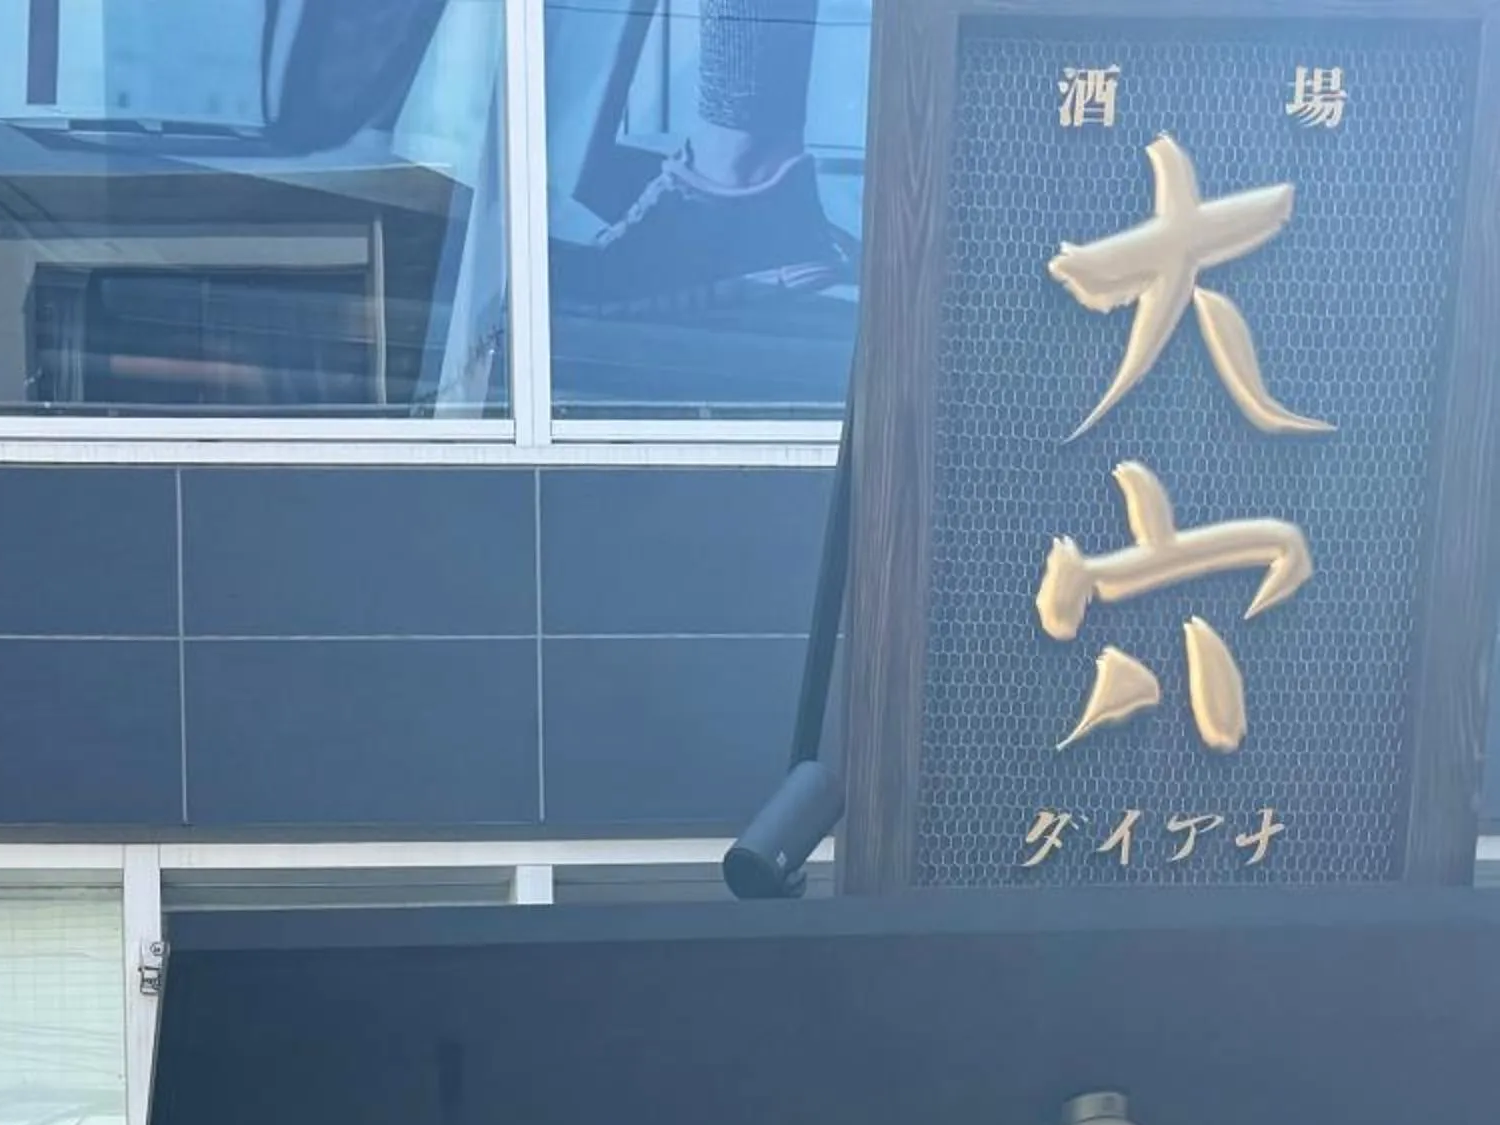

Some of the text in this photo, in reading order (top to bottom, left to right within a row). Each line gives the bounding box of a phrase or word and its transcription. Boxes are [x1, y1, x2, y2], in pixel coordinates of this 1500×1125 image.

[1058, 64, 1349, 130] 酒場
[1036, 132, 1338, 753] 大穴
[1022, 808, 1286, 868] ダイアナ
